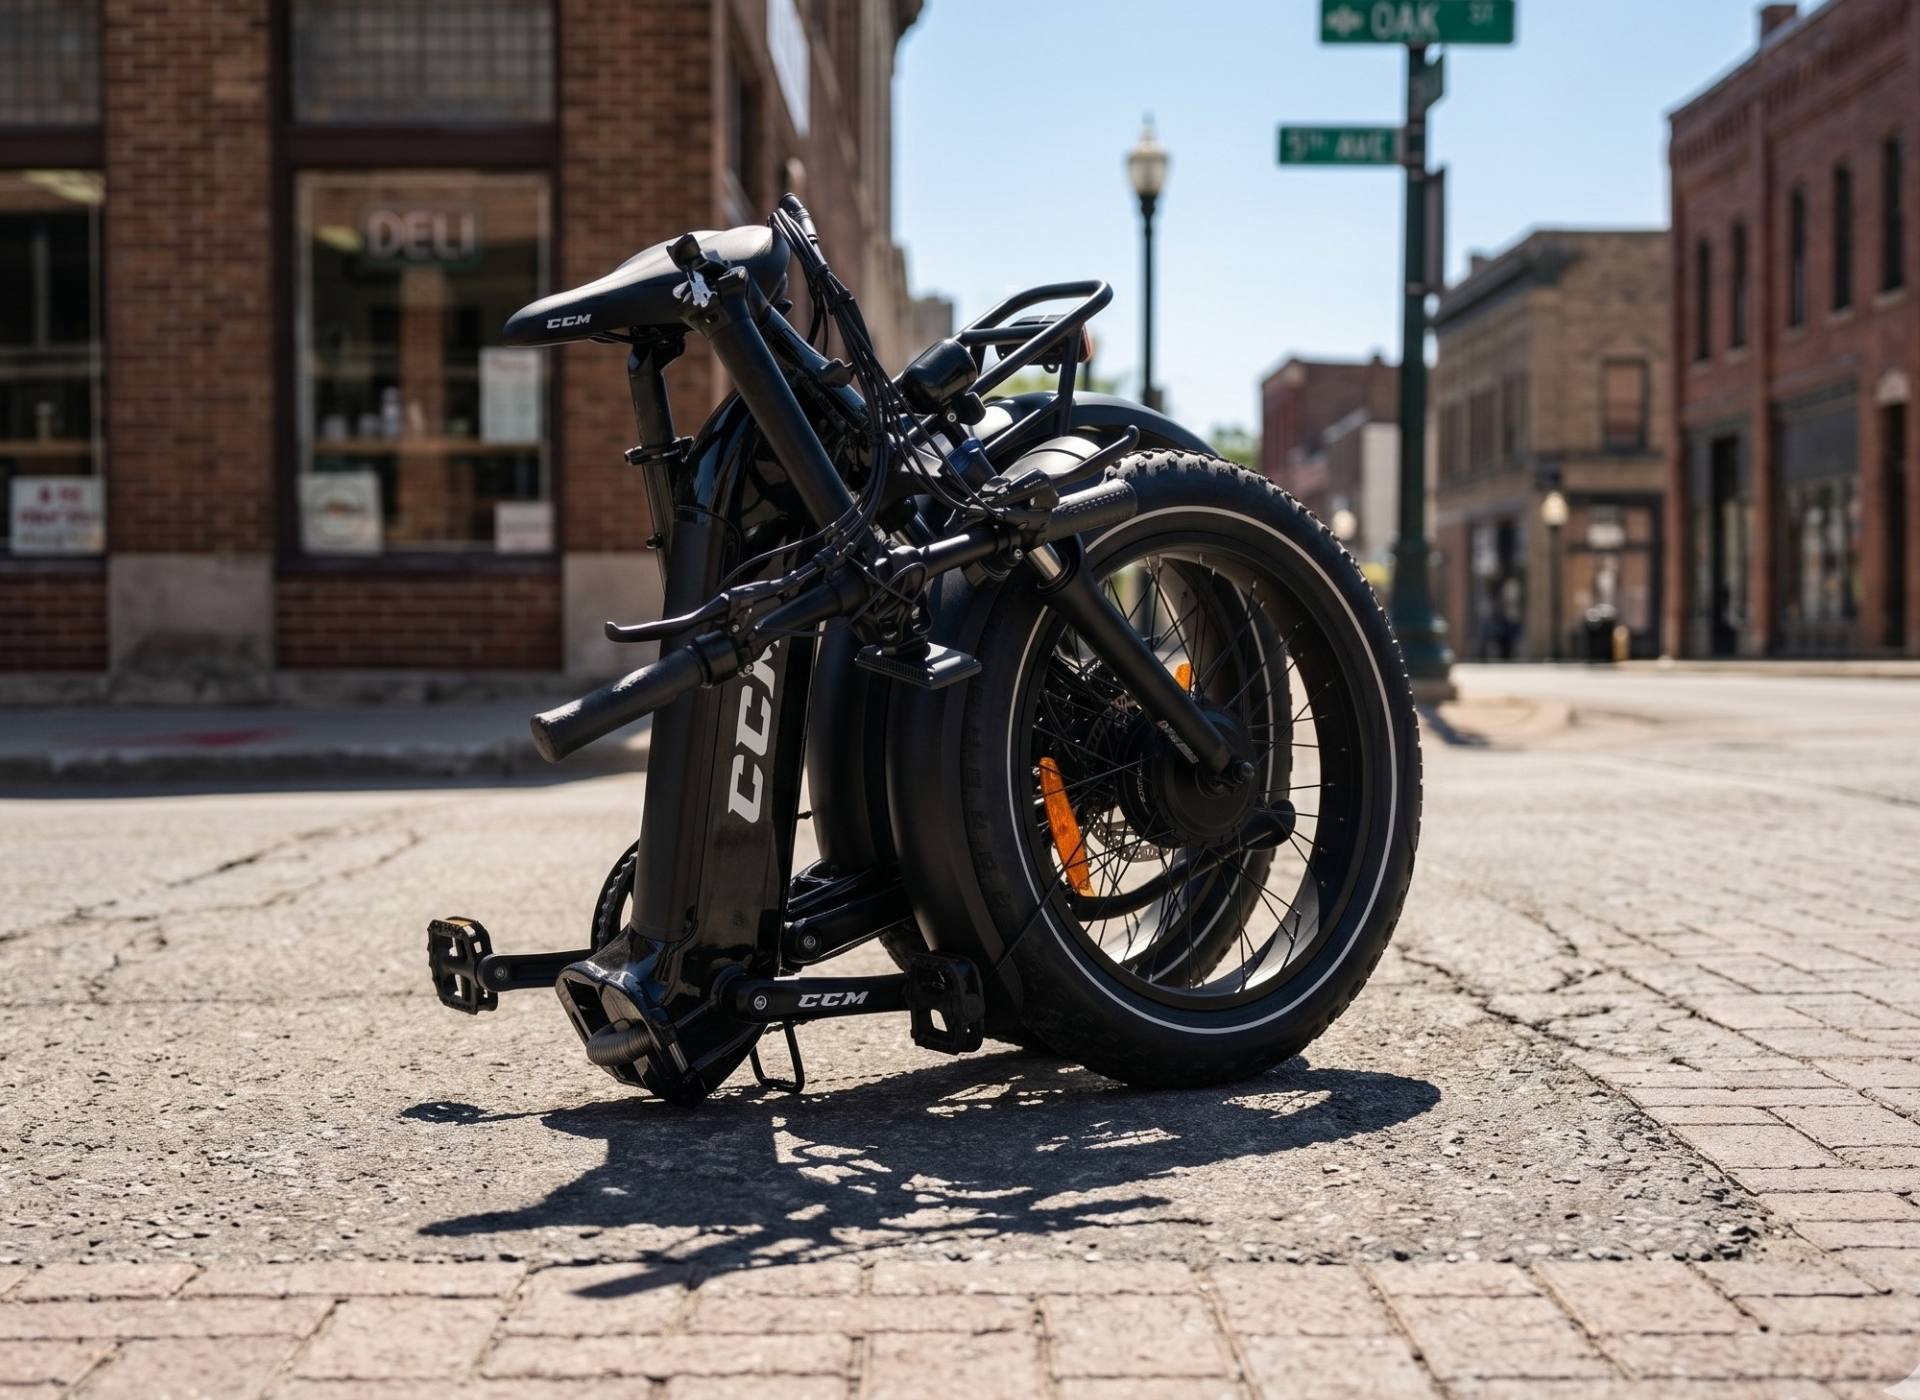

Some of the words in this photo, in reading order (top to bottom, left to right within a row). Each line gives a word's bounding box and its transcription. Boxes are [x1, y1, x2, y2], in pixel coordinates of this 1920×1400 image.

[1370, 3, 1439, 40] OAK
[1333, 133, 1386, 159] AVE
[367, 208, 476, 260] DELI
[546, 313, 592, 329] CCM
[798, 990, 870, 1008] CCM
